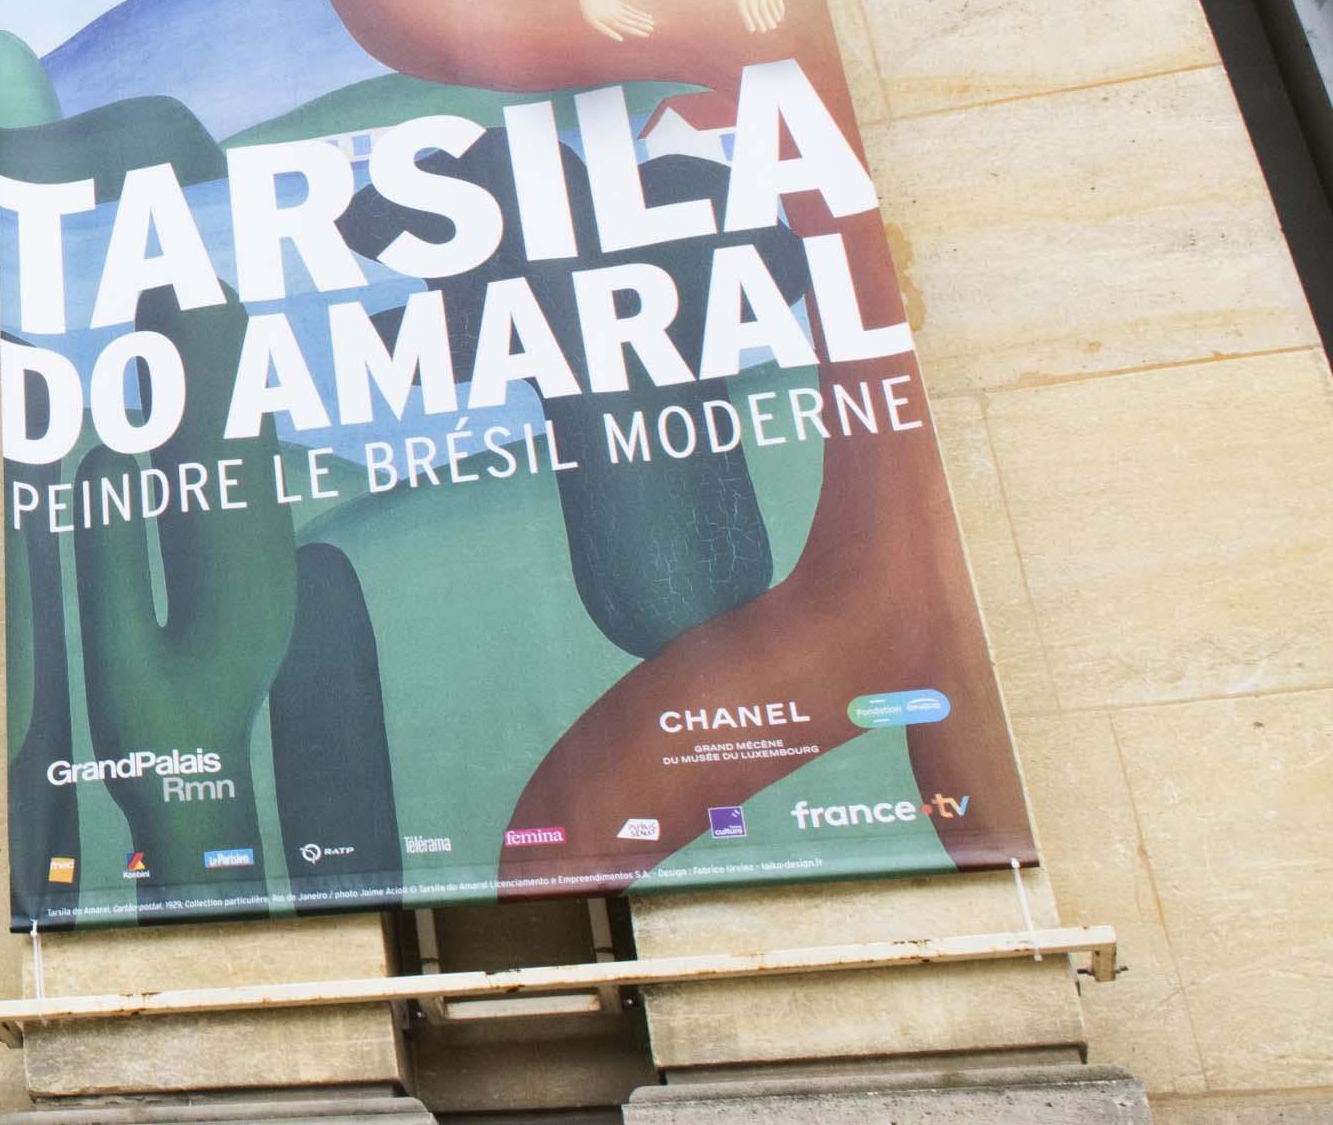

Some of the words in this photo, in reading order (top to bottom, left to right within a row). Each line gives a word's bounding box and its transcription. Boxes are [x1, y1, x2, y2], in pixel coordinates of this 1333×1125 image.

[0, 329, 187, 465] DO
[223, 233, 916, 439] AMARAL
[12, 457, 248, 534] PEINDRE
[273, 446, 340, 504] LE
[364, 415, 578, 495] BRÉSIL
[605, 374, 923, 465] MODERNE
[659, 701, 811, 733] CHANEL
[662, 756, 679, 765] DU
[681, 751, 721, 764] MUSÉE
[722, 751, 739, 761] DU
[741, 745, 819, 760] LUXEMBOURG
[694, 740, 733, 753] GRAND
[46, 747, 222, 786] GrandPalais
[162, 777, 236, 803] Rmn
[790, 799, 917, 829] france
[403, 835, 452, 854] Télérama
[505, 829, 564, 846] femina
[324, 846, 355, 855] RATP
[184, 898, 223, 908] Collection
[298, 891, 327, 901] Janeiro
[334, 890, 358, 900] photo
[360, 888, 383, 897] Jaime
